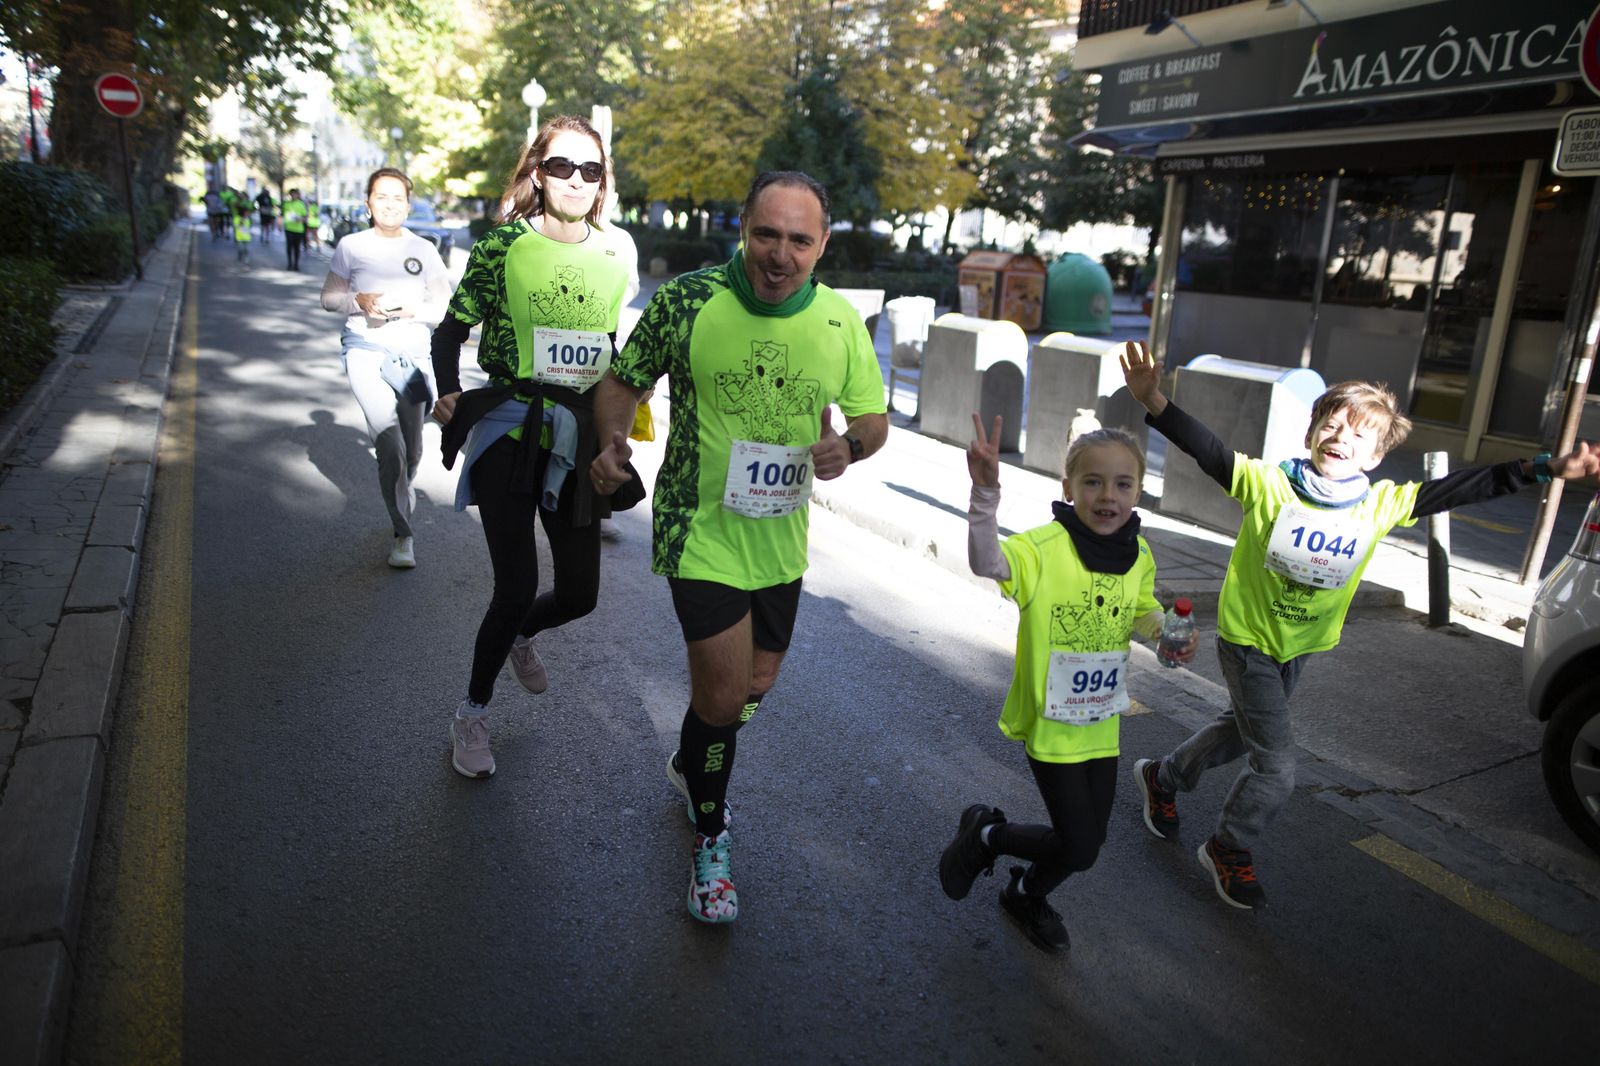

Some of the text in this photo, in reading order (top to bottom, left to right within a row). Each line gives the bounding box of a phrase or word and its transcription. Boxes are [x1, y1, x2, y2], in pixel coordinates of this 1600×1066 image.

[1117, 51, 1222, 85] COFFEE & BREAKFAST
[1293, 20, 1586, 98] AMAZÔNICA
[1128, 91, 1200, 115] SWEET SAVORY
[547, 343, 602, 366] 1007
[746, 460, 808, 486] 1000
[748, 488, 767, 496] PAPA
[769, 489, 787, 497] JOSE
[1291, 526, 1357, 560] 1044
[1311, 556, 1329, 566] ISCO
[1072, 668, 1119, 693] 994
